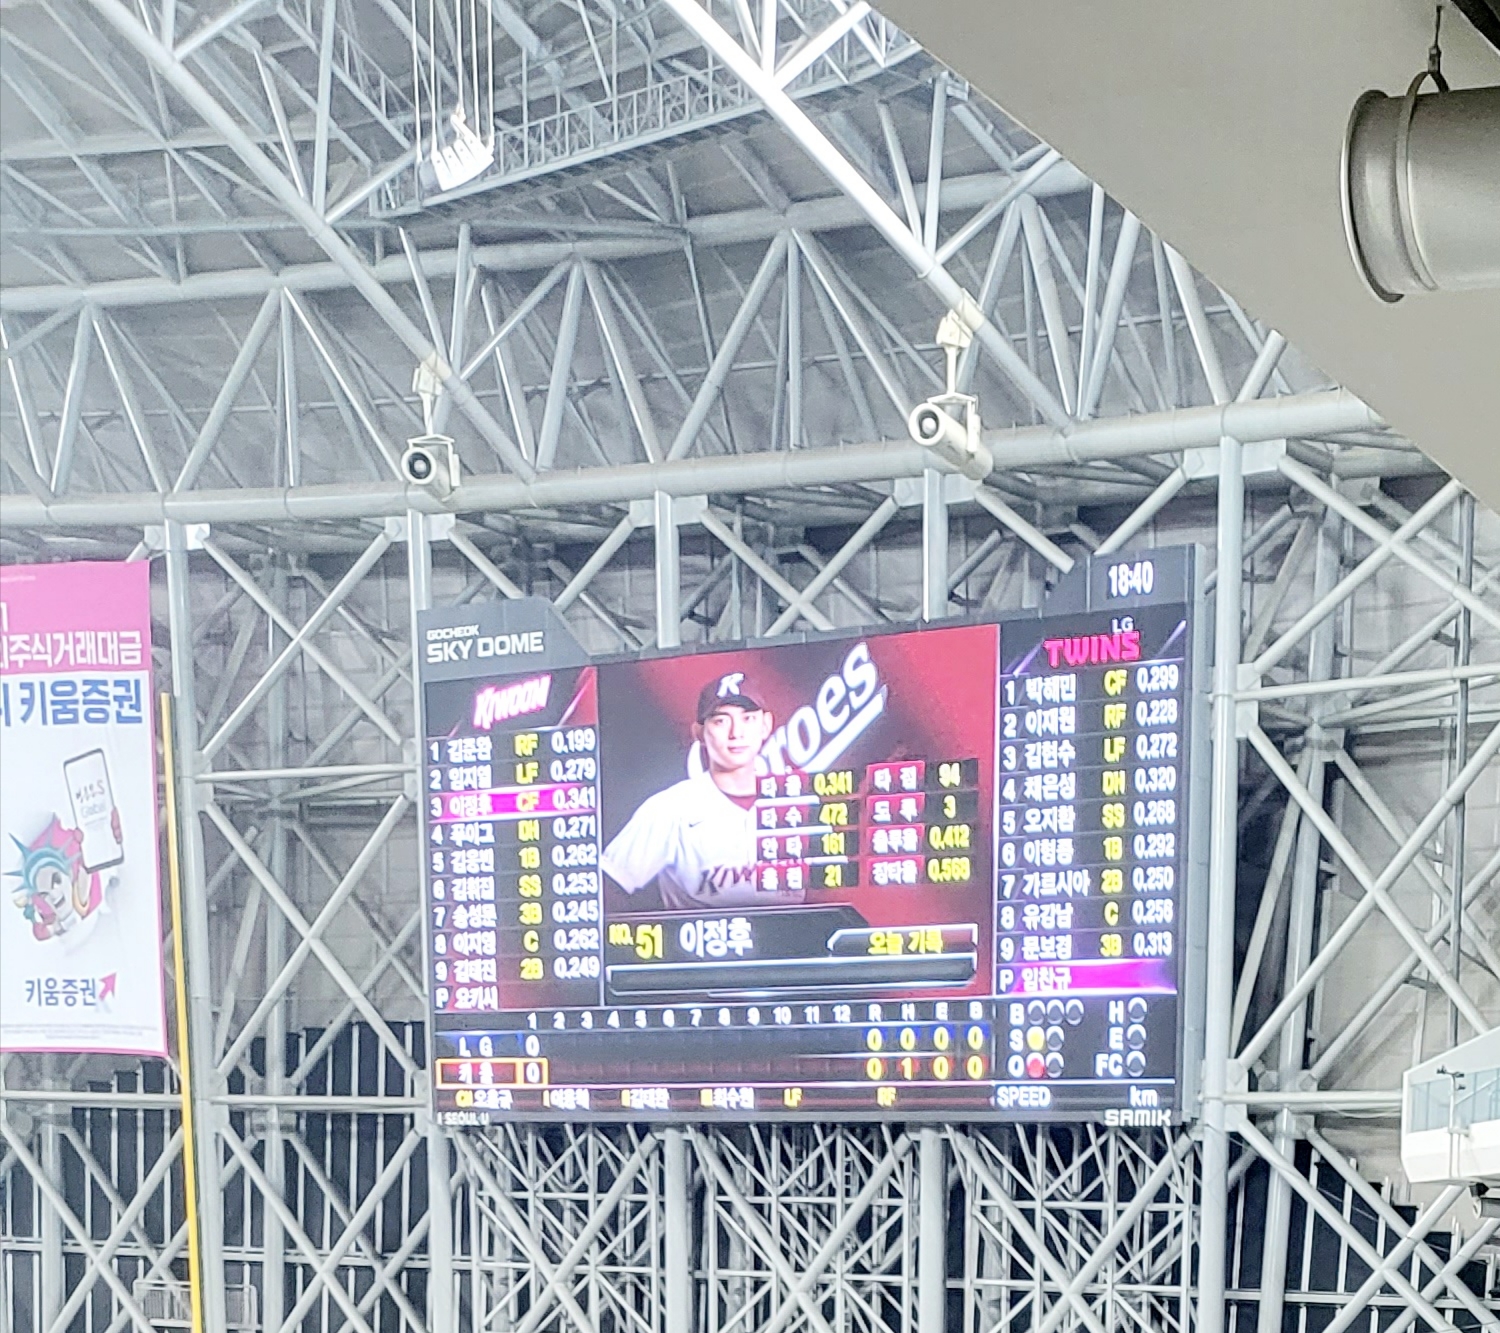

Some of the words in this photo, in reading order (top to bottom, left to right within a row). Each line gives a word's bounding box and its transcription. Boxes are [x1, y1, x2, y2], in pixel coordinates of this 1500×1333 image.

[1108, 561, 1154, 597] 18:40
[426, 625, 480, 641] GOCHEOK
[1112, 617, 1134, 633] LG
[0, 631, 142, 670] 주식거래대금
[427, 639, 473, 663] SKY
[477, 631, 544, 658] DOME
[1044, 631, 1140, 668] TWINS
[1026, 674, 1076, 704] 박해민
[1104, 669, 1128, 696] CF
[1136, 664, 1179, 694] 0.299
[20, 679, 143, 727] 키움증권
[1025, 706, 1075, 737] 이재원
[1104, 703, 1127, 729] RF
[1135, 698, 1178, 727] 0.228
[447, 736, 492, 763] 김준완
[514, 734, 538, 756] RF
[551, 729, 595, 754] 0.199
[1024, 739, 1076, 770] 김현수
[1104, 736, 1126, 762] LF
[1136, 732, 1178, 760] 0.272
[516, 762, 539, 783] LF
[551, 758, 596, 781] 0.279
[813, 771, 852, 796] 0.341
[1024, 772, 1076, 802] 채은성
[1102, 770, 1126, 796] DH
[1134, 766, 1177, 794] 0.320
[552, 787, 595, 810] 0.341
[943, 795, 956, 819] 3
[1023, 805, 1075, 834] 오지환
[1101, 803, 1125, 829] SS
[1134, 799, 1175, 827] 0.268
[450, 822, 495, 846] 푸이그
[553, 815, 595, 839] 0.271
[928, 824, 970, 850] 0.412
[519, 847, 540, 868] 1B
[552, 843, 597, 867] 0.262
[1023, 838, 1074, 866] 이형종
[1103, 836, 1123, 860] 1B
[1134, 833, 1175, 860] 0.292
[519, 874, 542, 898] SS
[552, 872, 598, 895] 0.253
[824, 865, 841, 888] 21
[1023, 869, 1091, 899] 가르시아
[1101, 869, 1123, 893] 2B
[1132, 866, 1174, 892] 0.250
[552, 900, 599, 923] 0.245
[1022, 902, 1073, 930] 유강남
[1104, 901, 1118, 926] C
[523, 930, 539, 953] C
[553, 928, 600, 951] 0.262
[635, 924, 663, 960] 51
[679, 917, 753, 958] 이정후
[868, 930, 904, 955] 오늘
[908, 929, 943, 954] 기록
[1022, 934, 1072, 961] 문보경
[1100, 933, 1122, 957] 3B
[1133, 931, 1172, 956] 0.313
[553, 956, 600, 979] 0.249
[1000, 969, 1014, 992] P
[1022, 966, 1072, 992] 임찬규
[25, 977, 97, 1007] 키움증권
[435, 988, 449, 1008] P
[454, 985, 498, 1011] 요키시
[527, 1012, 537, 1030] 1
[553, 1011, 565, 1030] 2
[580, 1011, 593, 1029] 3
[607, 1010, 620, 1029] 4
[634, 1010, 647, 1028] 5
[662, 1009, 675, 1028] 6
[690, 1008, 702, 1027] 7
[718, 1007, 730, 1026] 8
[747, 1006, 760, 1026] 9
[773, 1006, 792, 1025] 10
[804, 1005, 820, 1025] 11
[832, 1004, 851, 1023] 12
[869, 1003, 882, 1022] R
[901, 1003, 915, 1021] H
[935, 1002, 948, 1020] E
[969, 1001, 983, 1020] B
[1009, 1003, 1024, 1025] B
[1109, 1000, 1124, 1024] H
[525, 1034, 540, 1057] 0
[867, 1028, 882, 1051] 0
[900, 1027, 915, 1050] 0
[934, 1026, 949, 1050] 0
[968, 1026, 983, 1050] 0
[1009, 1029, 1024, 1051] S
[1109, 1026, 1124, 1050] E
[526, 1062, 540, 1083] 0
[866, 1057, 882, 1080] 0
[901, 1057, 913, 1080] 1
[933, 1056, 949, 1080] 0
[967, 1055, 983, 1080] 0
[1008, 1054, 1024, 1078] O
[1095, 1053, 1123, 1077] FC
[997, 1086, 1051, 1107] SPEED
[1129, 1085, 1158, 1107] km
[1104, 1109, 1172, 1127] SAMIK
